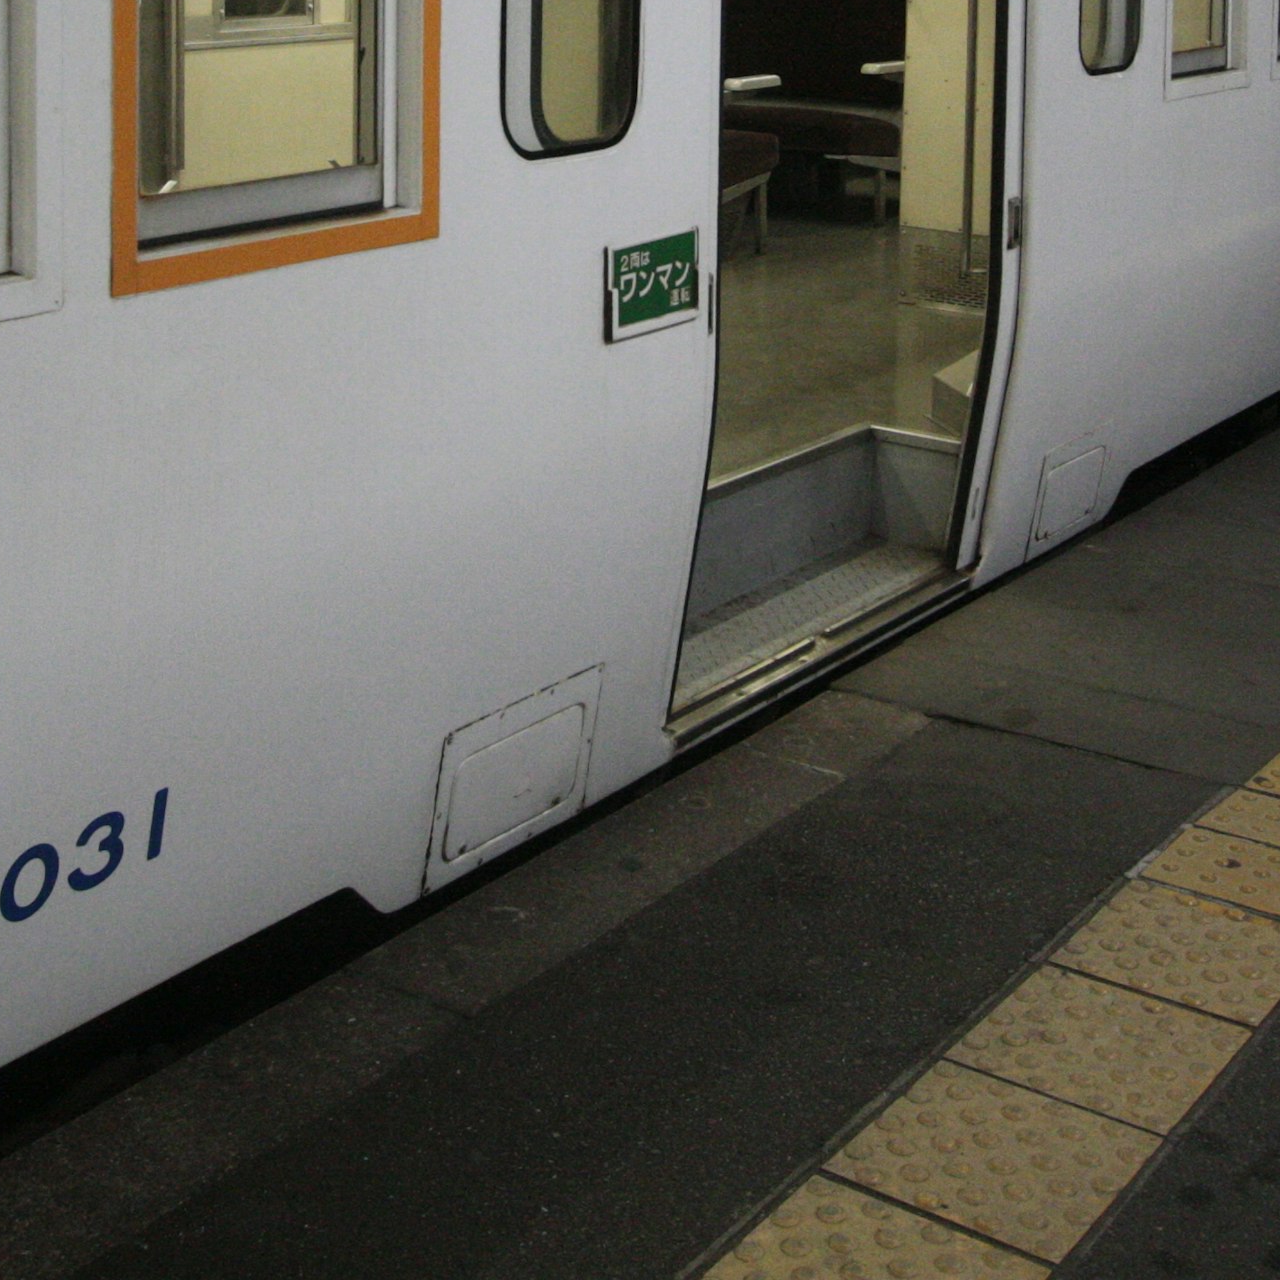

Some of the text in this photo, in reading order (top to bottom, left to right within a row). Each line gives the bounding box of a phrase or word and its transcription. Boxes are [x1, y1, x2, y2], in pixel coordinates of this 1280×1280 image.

[620, 251, 651, 273] 2両は
[620, 261, 690, 303] ワンマン
[669, 286, 691, 307] 運転
